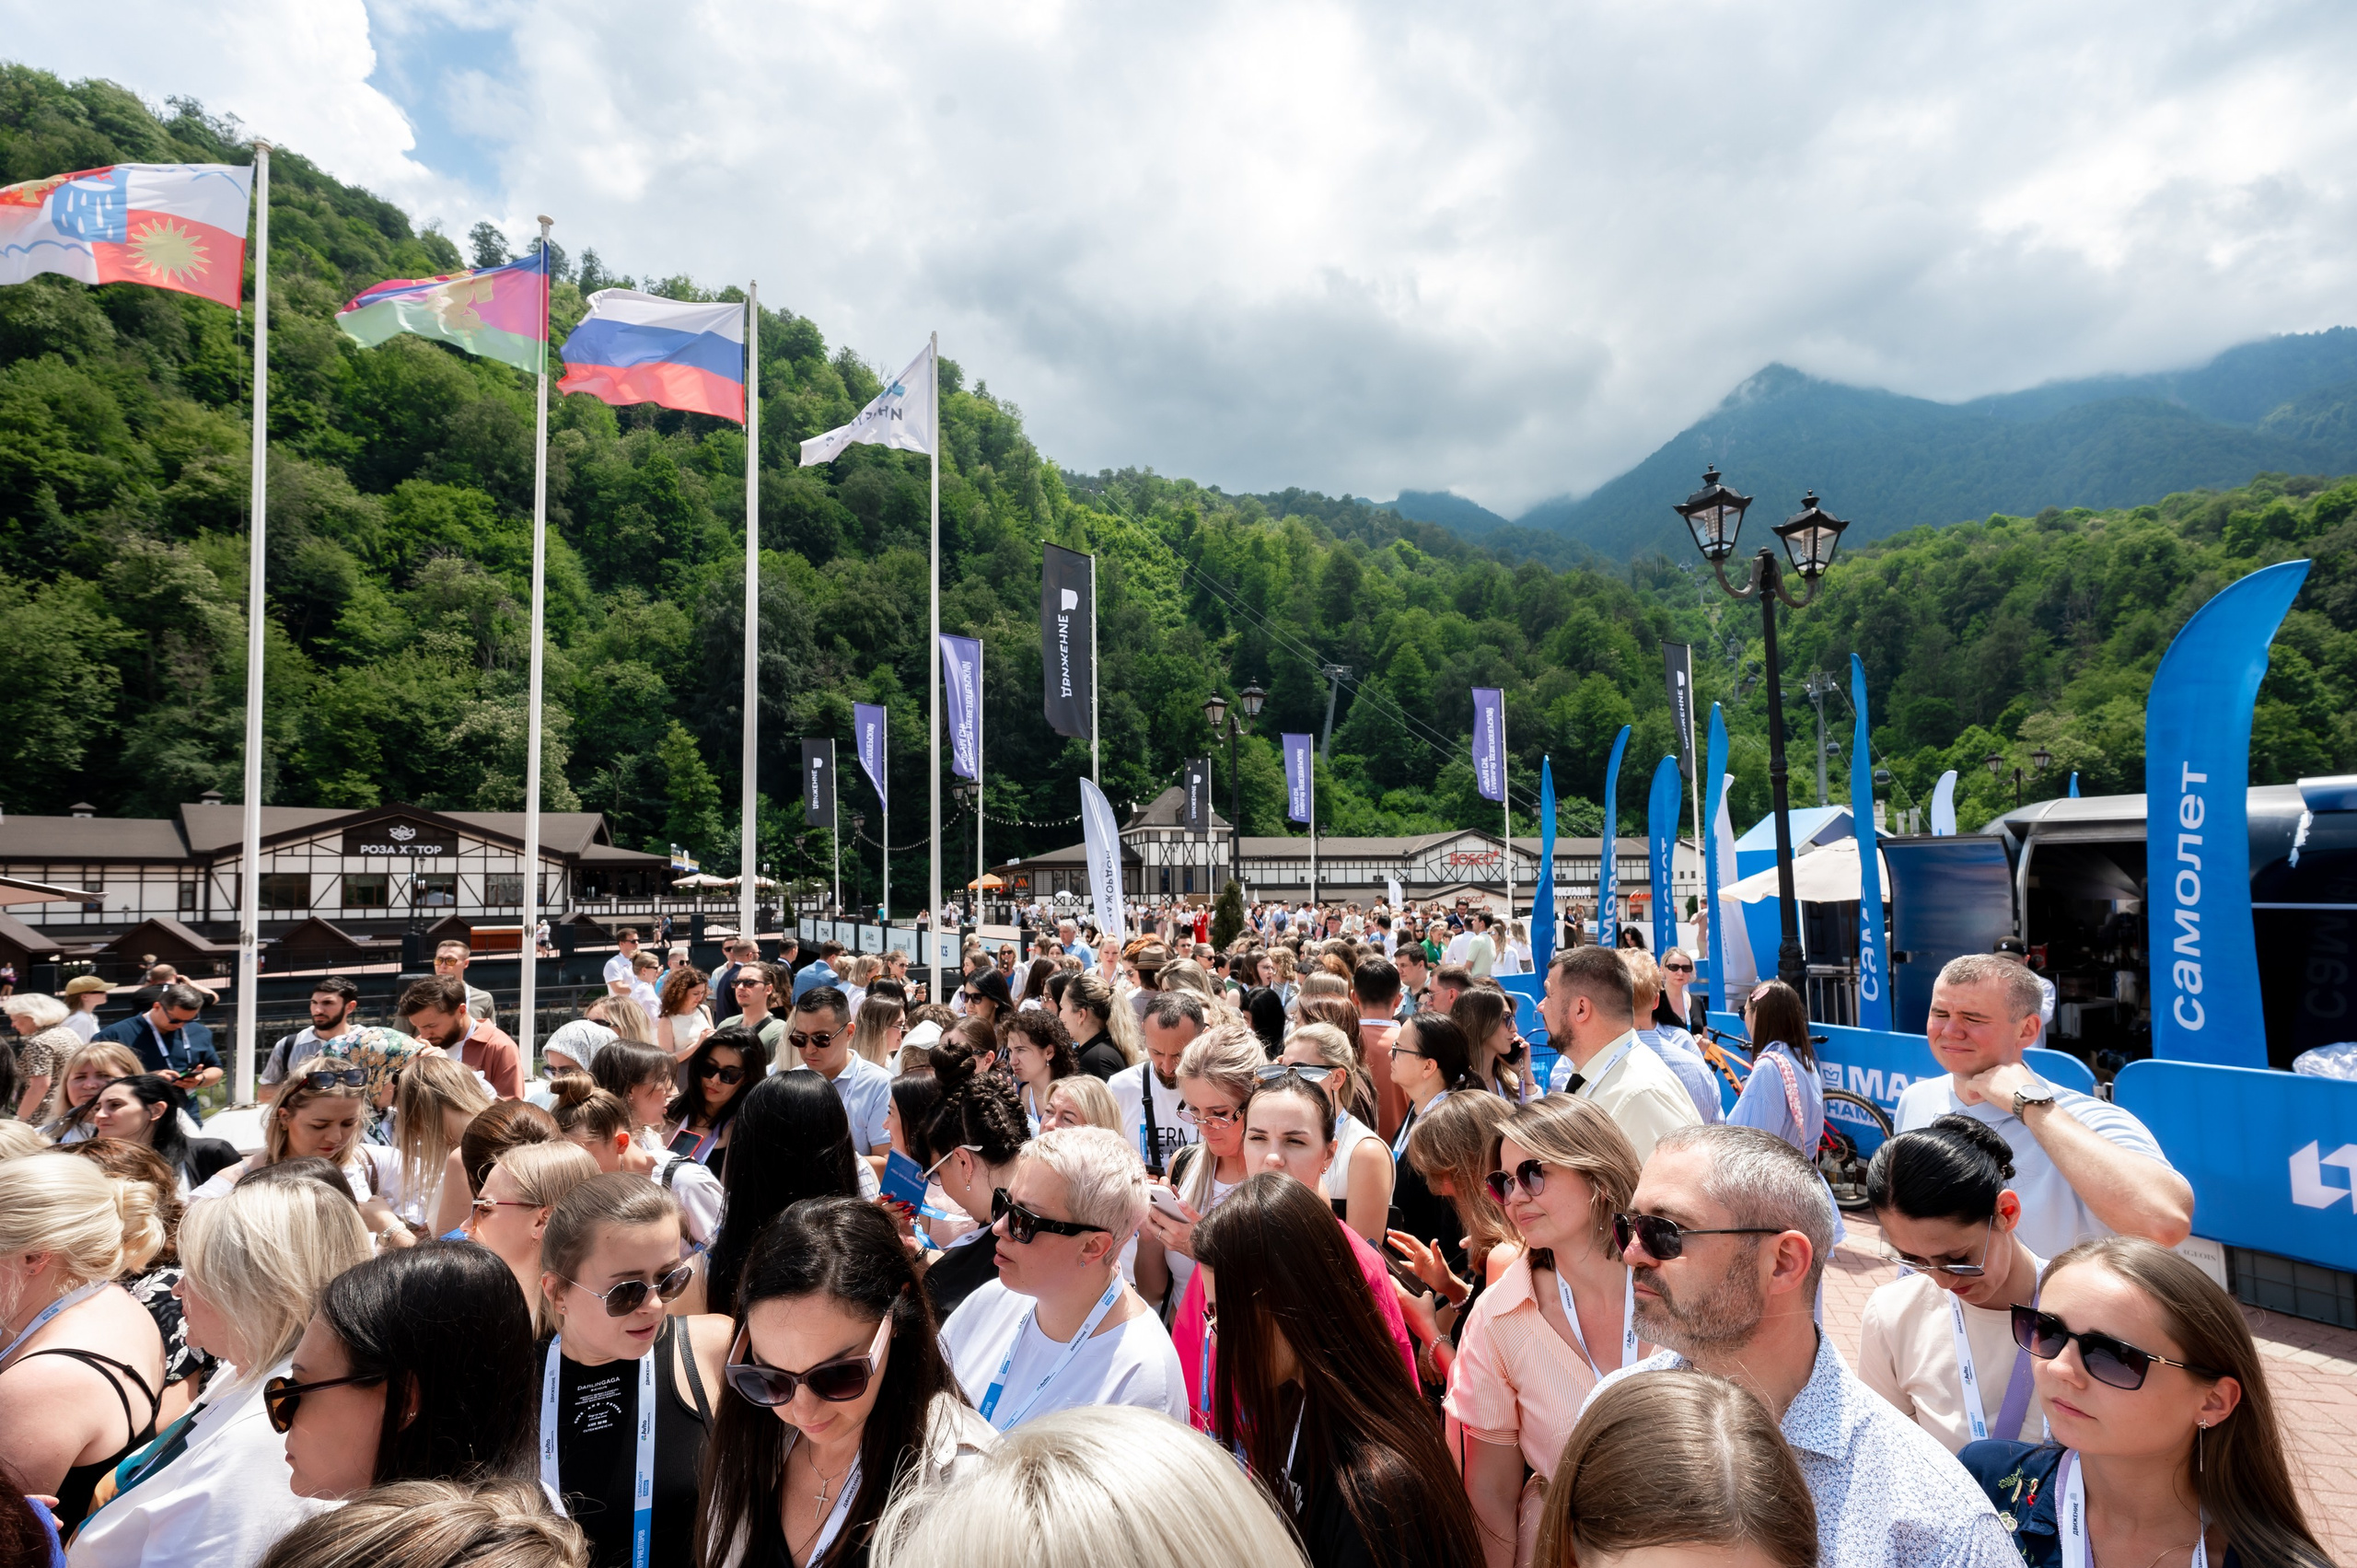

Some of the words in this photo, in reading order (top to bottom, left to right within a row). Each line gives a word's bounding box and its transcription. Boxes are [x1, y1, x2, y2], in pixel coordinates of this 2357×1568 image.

[360, 844, 396, 854] РОЗА
[399, 844, 442, 854] ХТОР
[1450, 853, 1494, 865] BOSCO
[2173, 761, 2208, 1032] самолет
[1969, 1411, 1979, 1436] самолет
[842, 1473, 861, 1508] ДВИЖЕНИЕ
